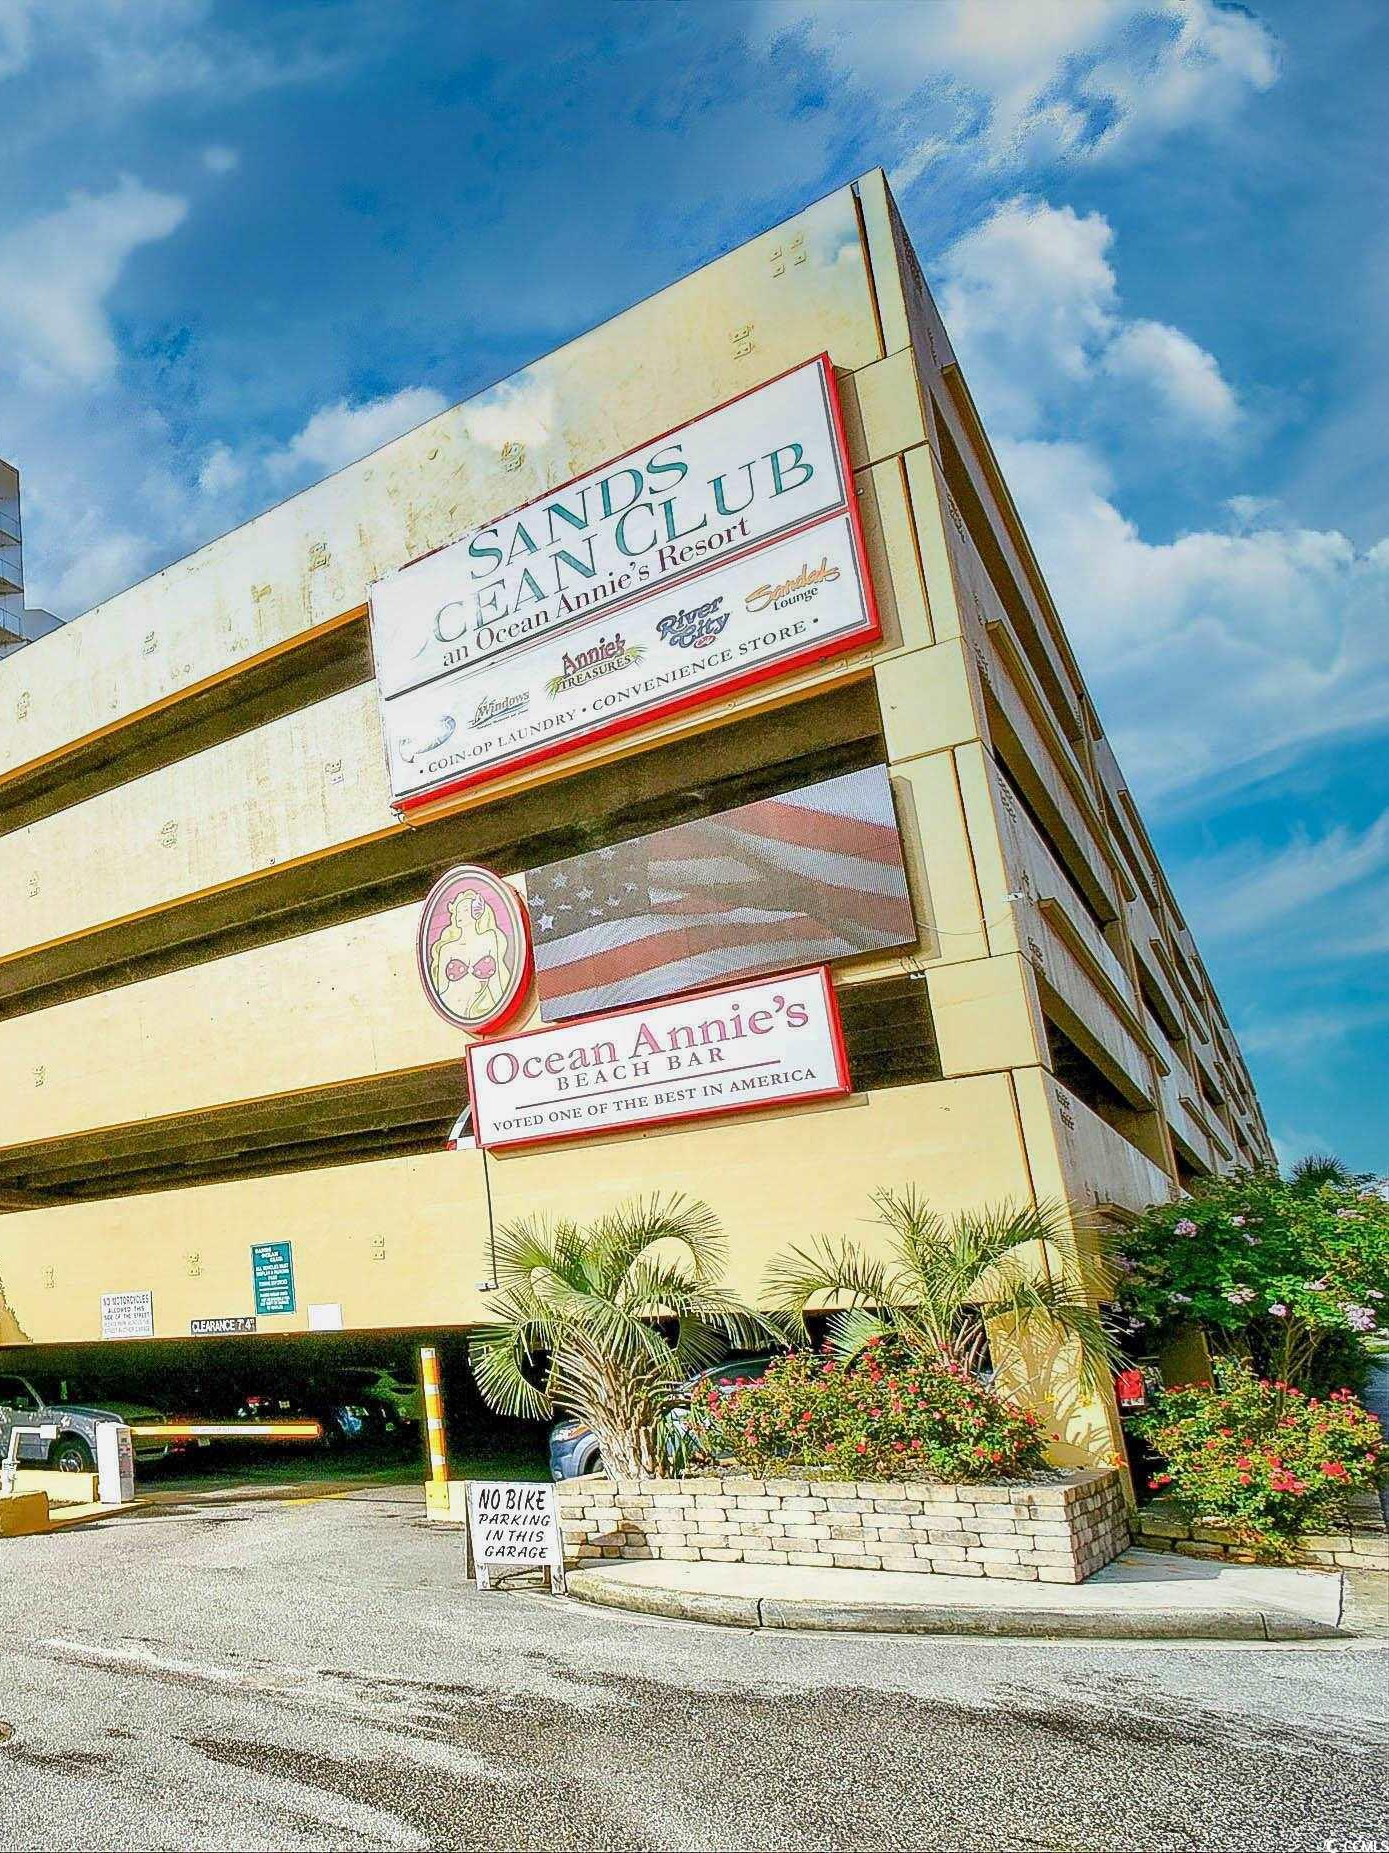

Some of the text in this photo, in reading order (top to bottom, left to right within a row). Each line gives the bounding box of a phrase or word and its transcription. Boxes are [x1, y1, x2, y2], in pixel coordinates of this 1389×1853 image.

[468, 444, 688, 580] SANDS
[410, 443, 814, 660] CEAN CLUB
[442, 517, 751, 668] an Ocean Annie's Resort
[744, 557, 841, 612] Sandals
[772, 587, 819, 611] Lounge
[655, 596, 724, 641] River
[669, 612, 731, 649] City
[560, 653, 632, 690] TREASURES
[428, 741, 493, 773] COIN-OP
[498, 708, 577, 748] LAUNDRY
[592, 648, 733, 711] CONVENIENCE
[738, 620, 807, 656] STORE
[486, 995, 809, 1085] Ocean Annie's
[557, 1047, 725, 1091] BEACH BAR
[493, 1067, 817, 1132] VOTED ONE OF THE BEST IN AMERICA
[192, 1320, 236, 1333] CLEARANCE
[478, 1488, 547, 1511] NO BIKE
[478, 1513, 551, 1526] PARKING
[484, 1545, 549, 1559] GARAGE
[485, 1529, 545, 1543] IN THIS
